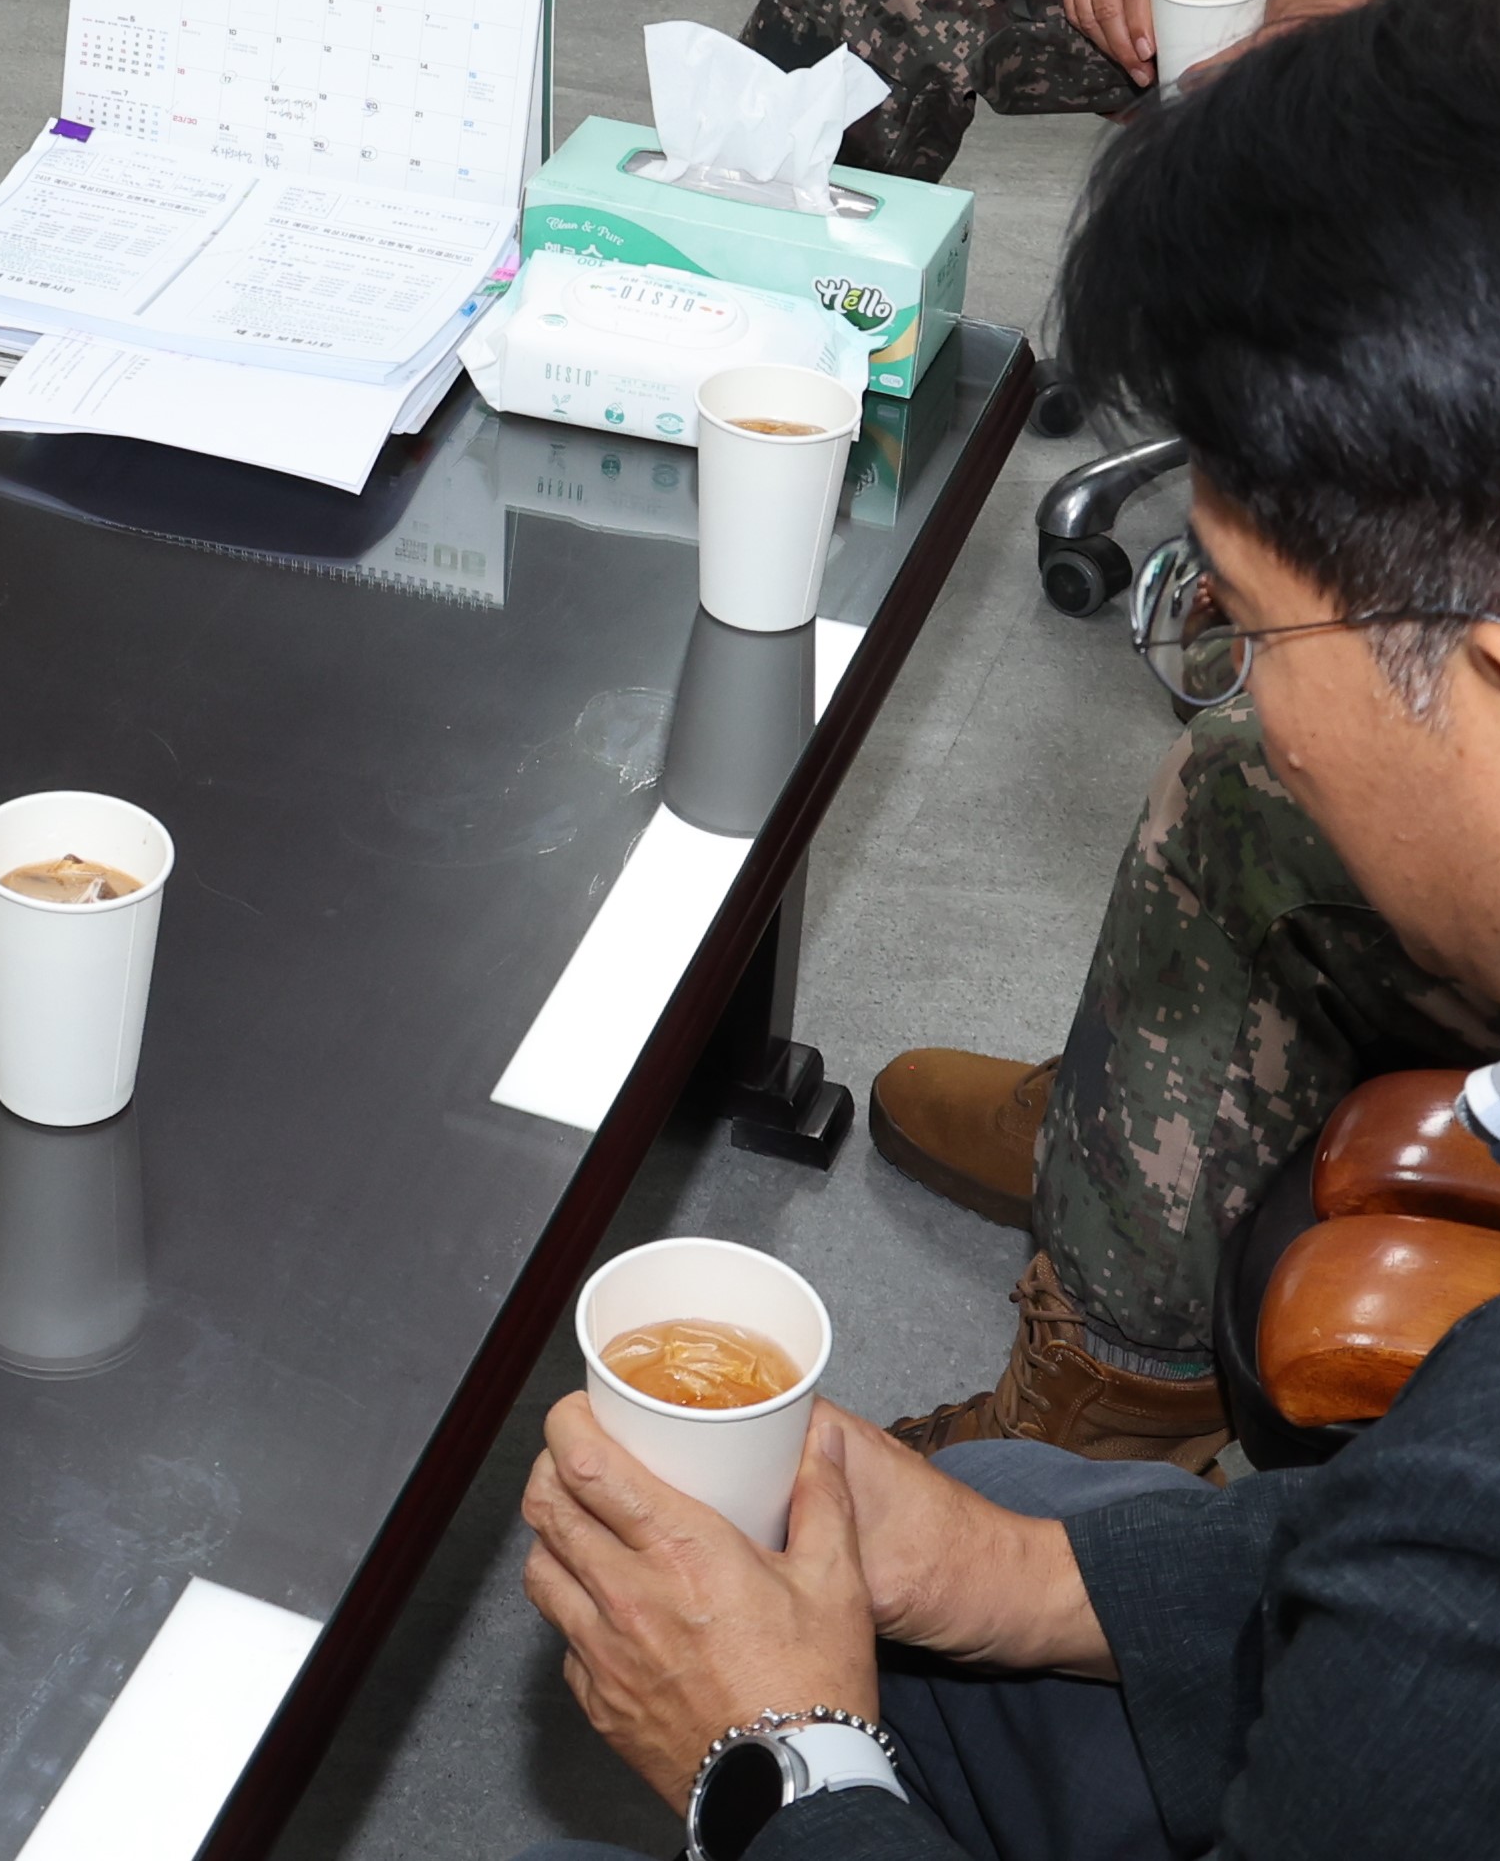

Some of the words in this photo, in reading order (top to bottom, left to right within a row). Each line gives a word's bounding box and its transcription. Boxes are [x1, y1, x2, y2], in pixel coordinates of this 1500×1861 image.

[229, 28, 237, 36] 10
[276, 36, 282, 44] 11
[323, 45, 332, 53] 12
[420, 62, 428, 70] 14
[469, 71, 477, 79] 15
[224, 75, 231, 83] 17
[319, 93, 327, 101] 19
[414, 110, 423, 118] 21
[463, 120, 474, 128] 22
[172, 115, 198, 125] 23/30
[219, 123, 230, 131] 24
[266, 132, 277, 140] 25
[361, 150, 372, 158] 27
[458, 168, 469, 176] 29
[546, 216, 578, 232] Clean
[581, 220, 596, 233] &
[597, 225, 625, 247] Pure
[619, 284, 696, 313] BESTO
[814, 278, 893, 321] Hello
[545, 362, 592, 388] BESTO
